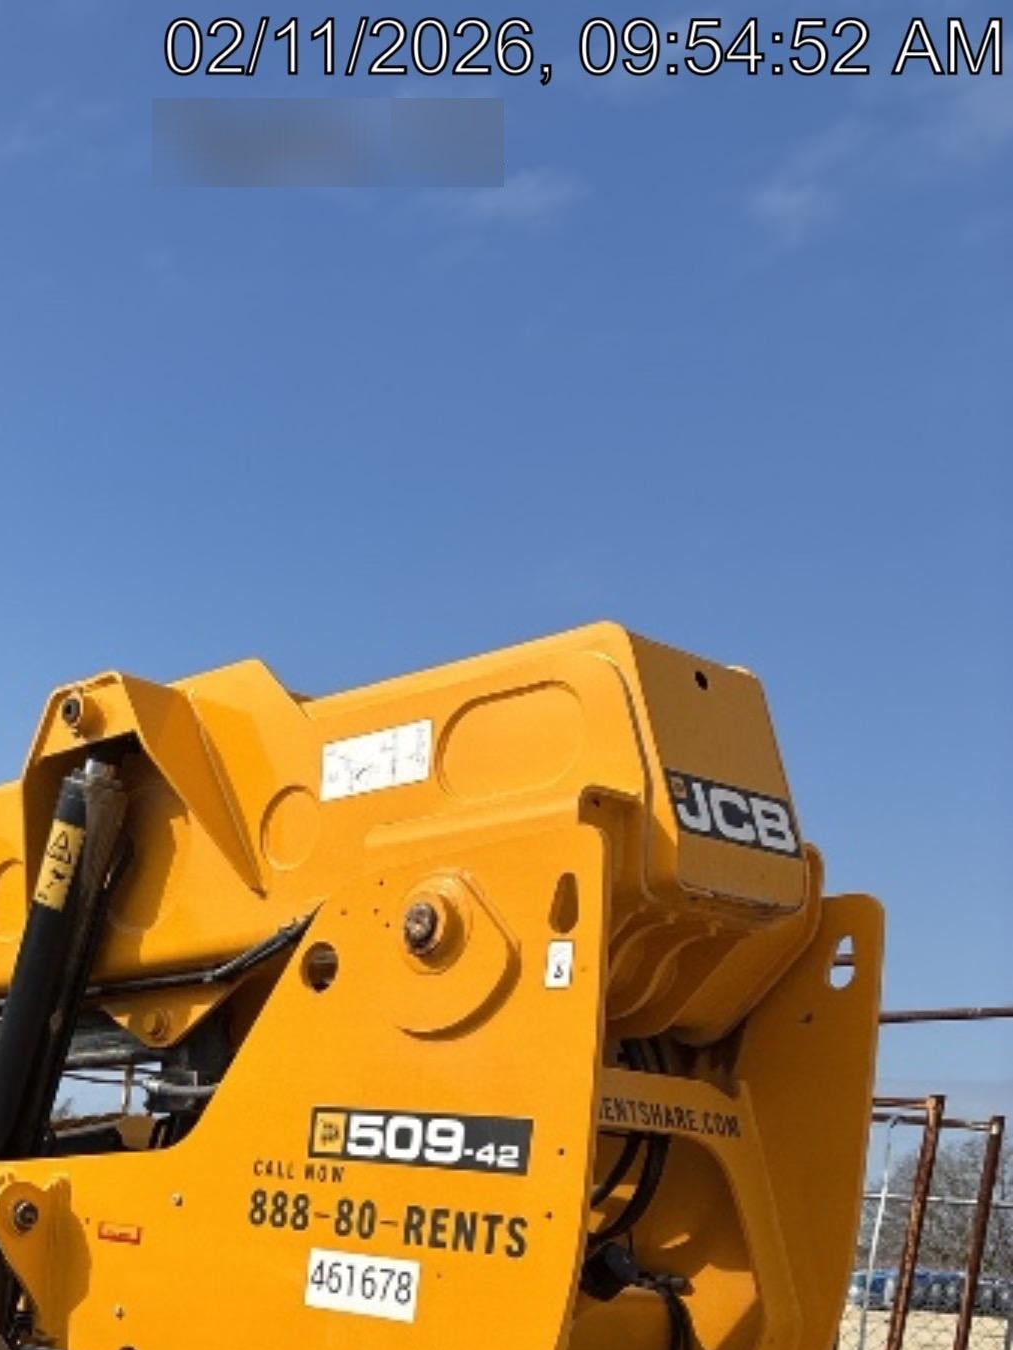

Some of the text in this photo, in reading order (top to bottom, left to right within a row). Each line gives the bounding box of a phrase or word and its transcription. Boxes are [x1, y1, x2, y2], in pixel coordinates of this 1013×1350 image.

[676, 781, 798, 854] JCB
[346, 1114, 520, 1169] 509-42
[253, 1159, 345, 1183] CALL NOW
[249, 1188, 528, 1258] 888-80-RENTS
[310, 1260, 413, 1304] 461678
